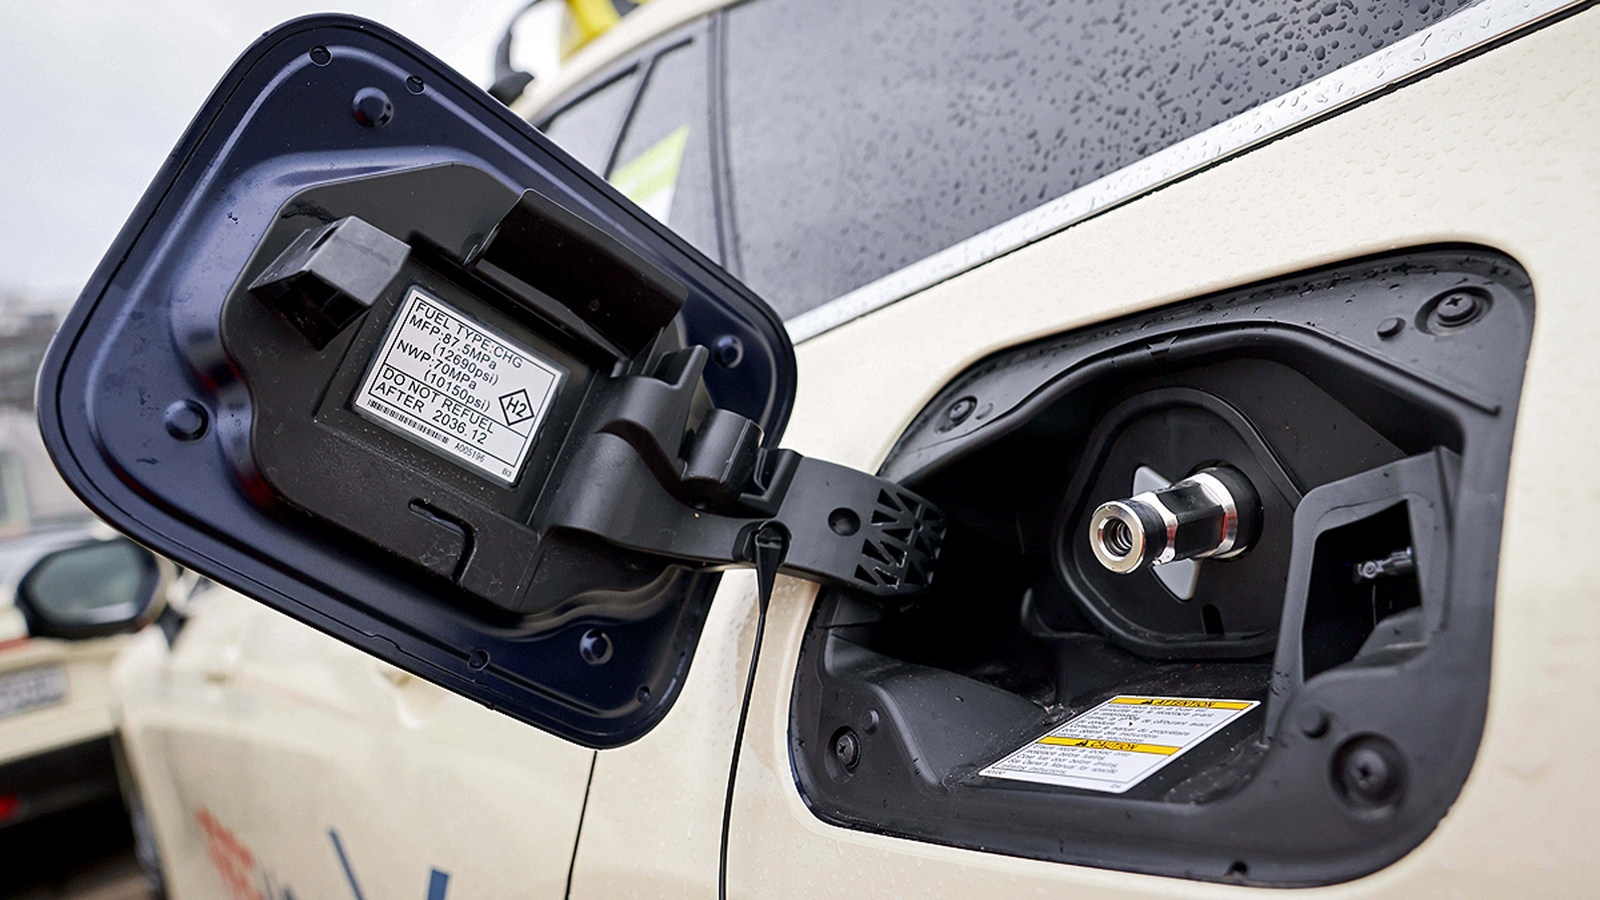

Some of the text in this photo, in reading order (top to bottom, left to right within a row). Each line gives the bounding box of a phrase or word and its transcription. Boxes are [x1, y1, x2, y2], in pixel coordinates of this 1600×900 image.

[415, 301, 524, 369] FUEL TYPE:CHG
[396, 339, 478, 390] NWP:70MPa
[432, 342, 499, 387] (12690psi)
[374, 382, 488, 445] AFTER 2036.12
[382, 367, 494, 434] DO NOT REFUEL
[423, 369, 491, 412] (10150psi)
[506, 397, 527, 418] H2
[1090, 740, 1139, 750] CAUTION
